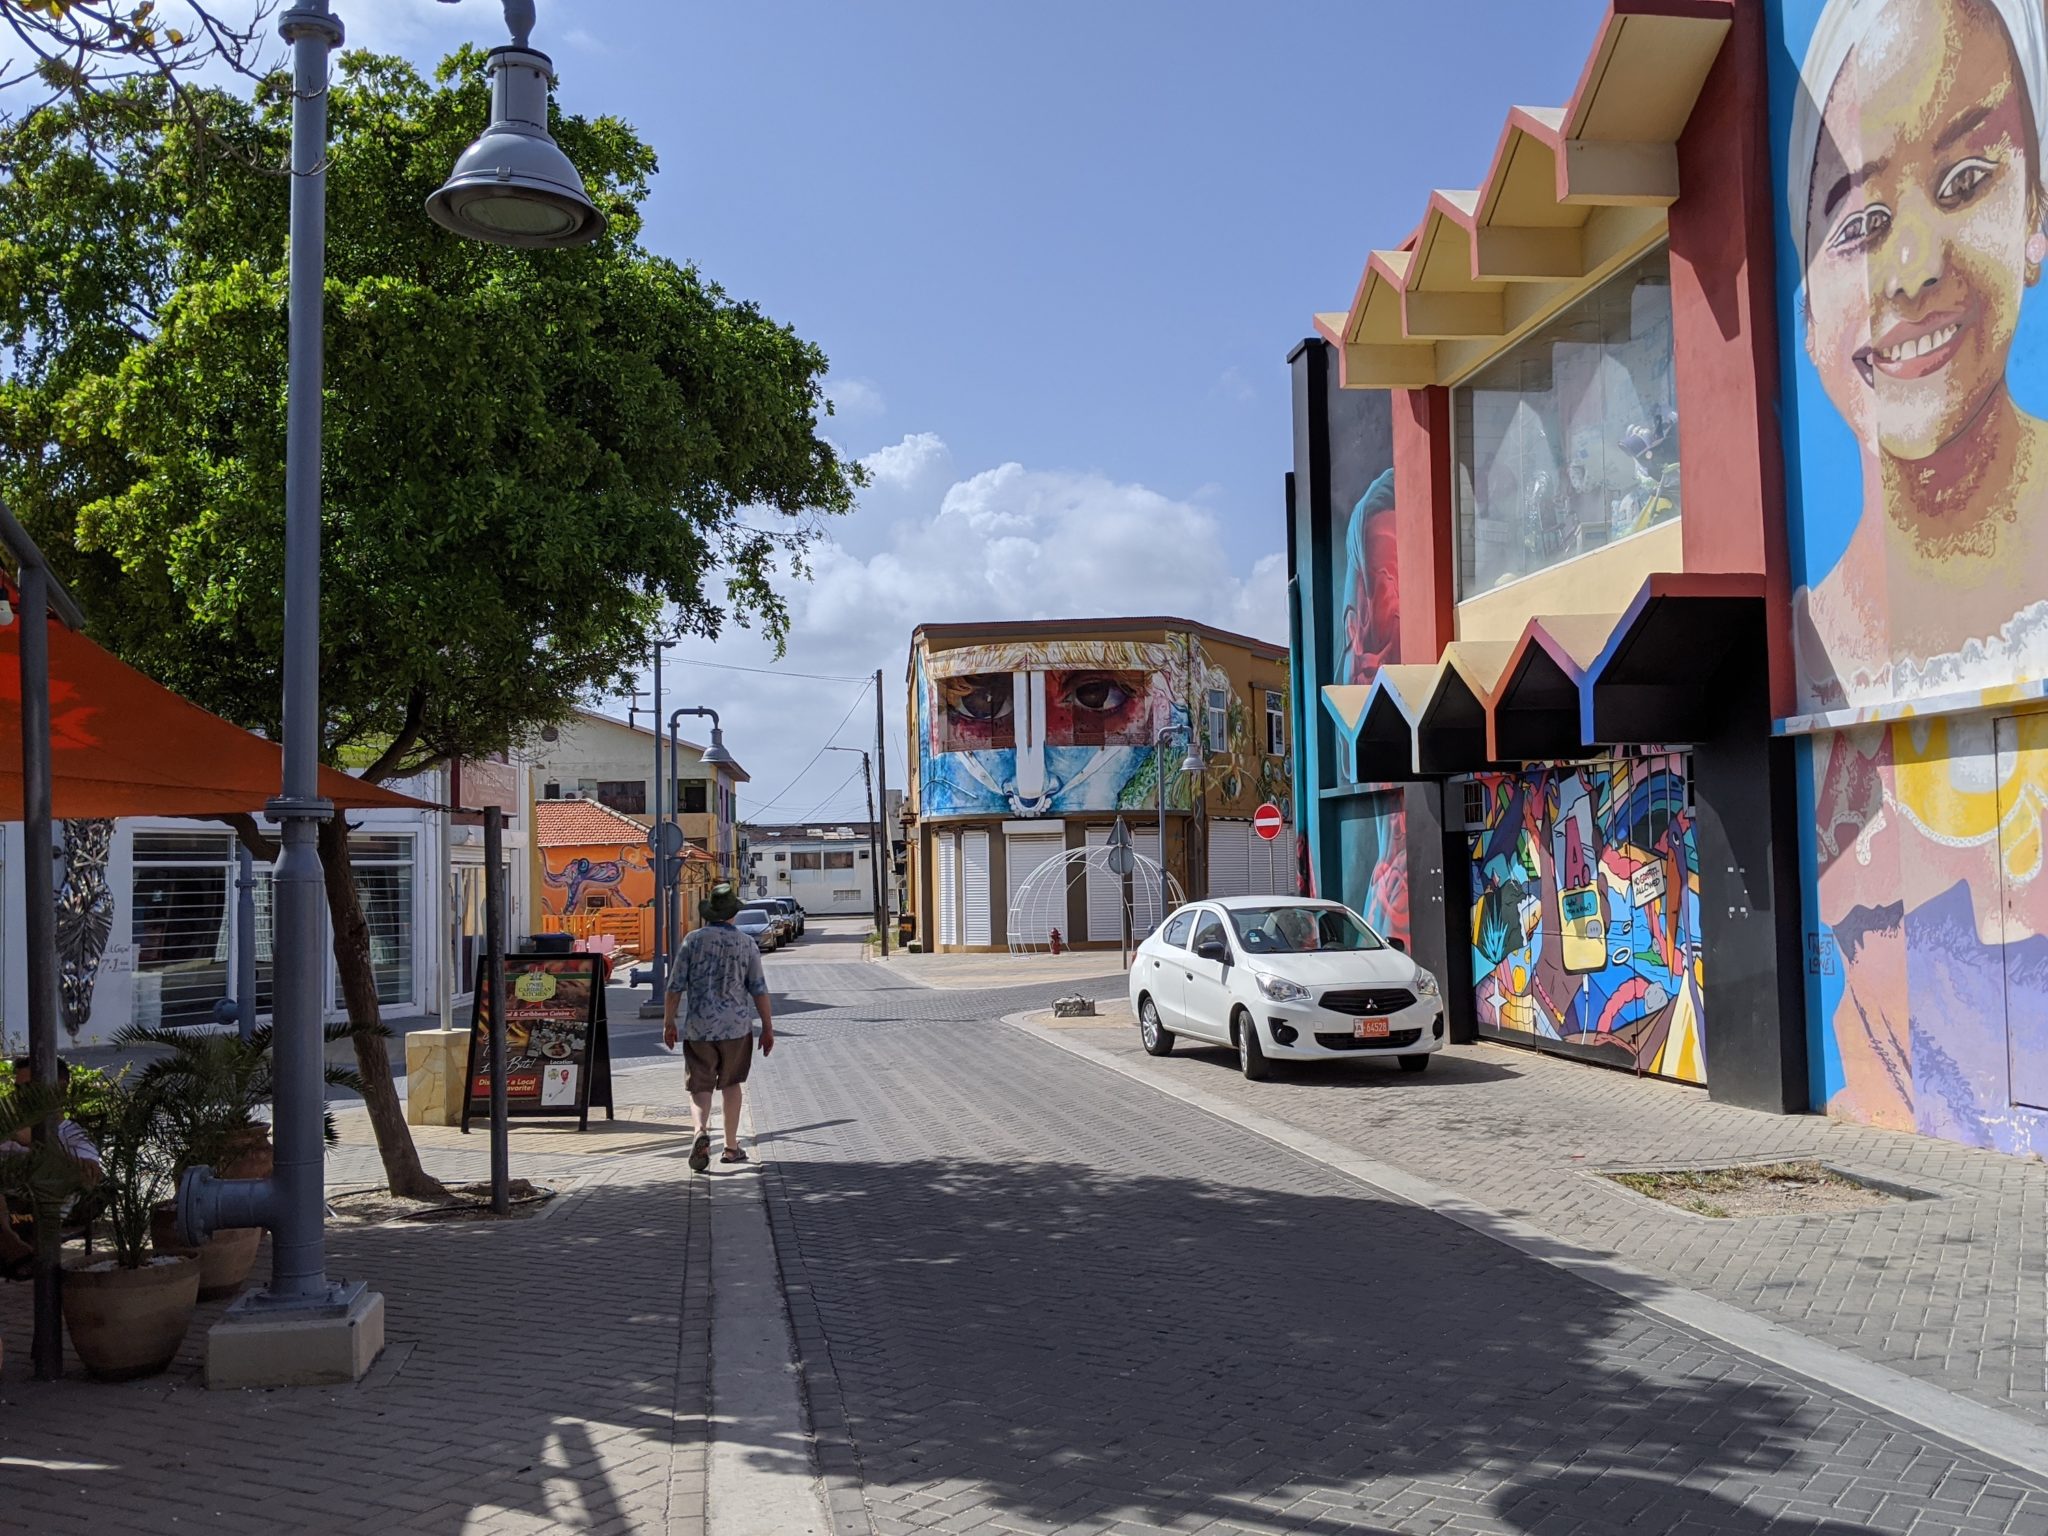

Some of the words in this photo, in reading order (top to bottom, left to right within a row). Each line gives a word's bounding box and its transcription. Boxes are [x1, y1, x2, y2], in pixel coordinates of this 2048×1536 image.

[1635, 877, 1661, 896] ALLOWED
[519, 1009, 549, 1017] Caribbean
[1366, 1022, 1387, 1033] 64528
